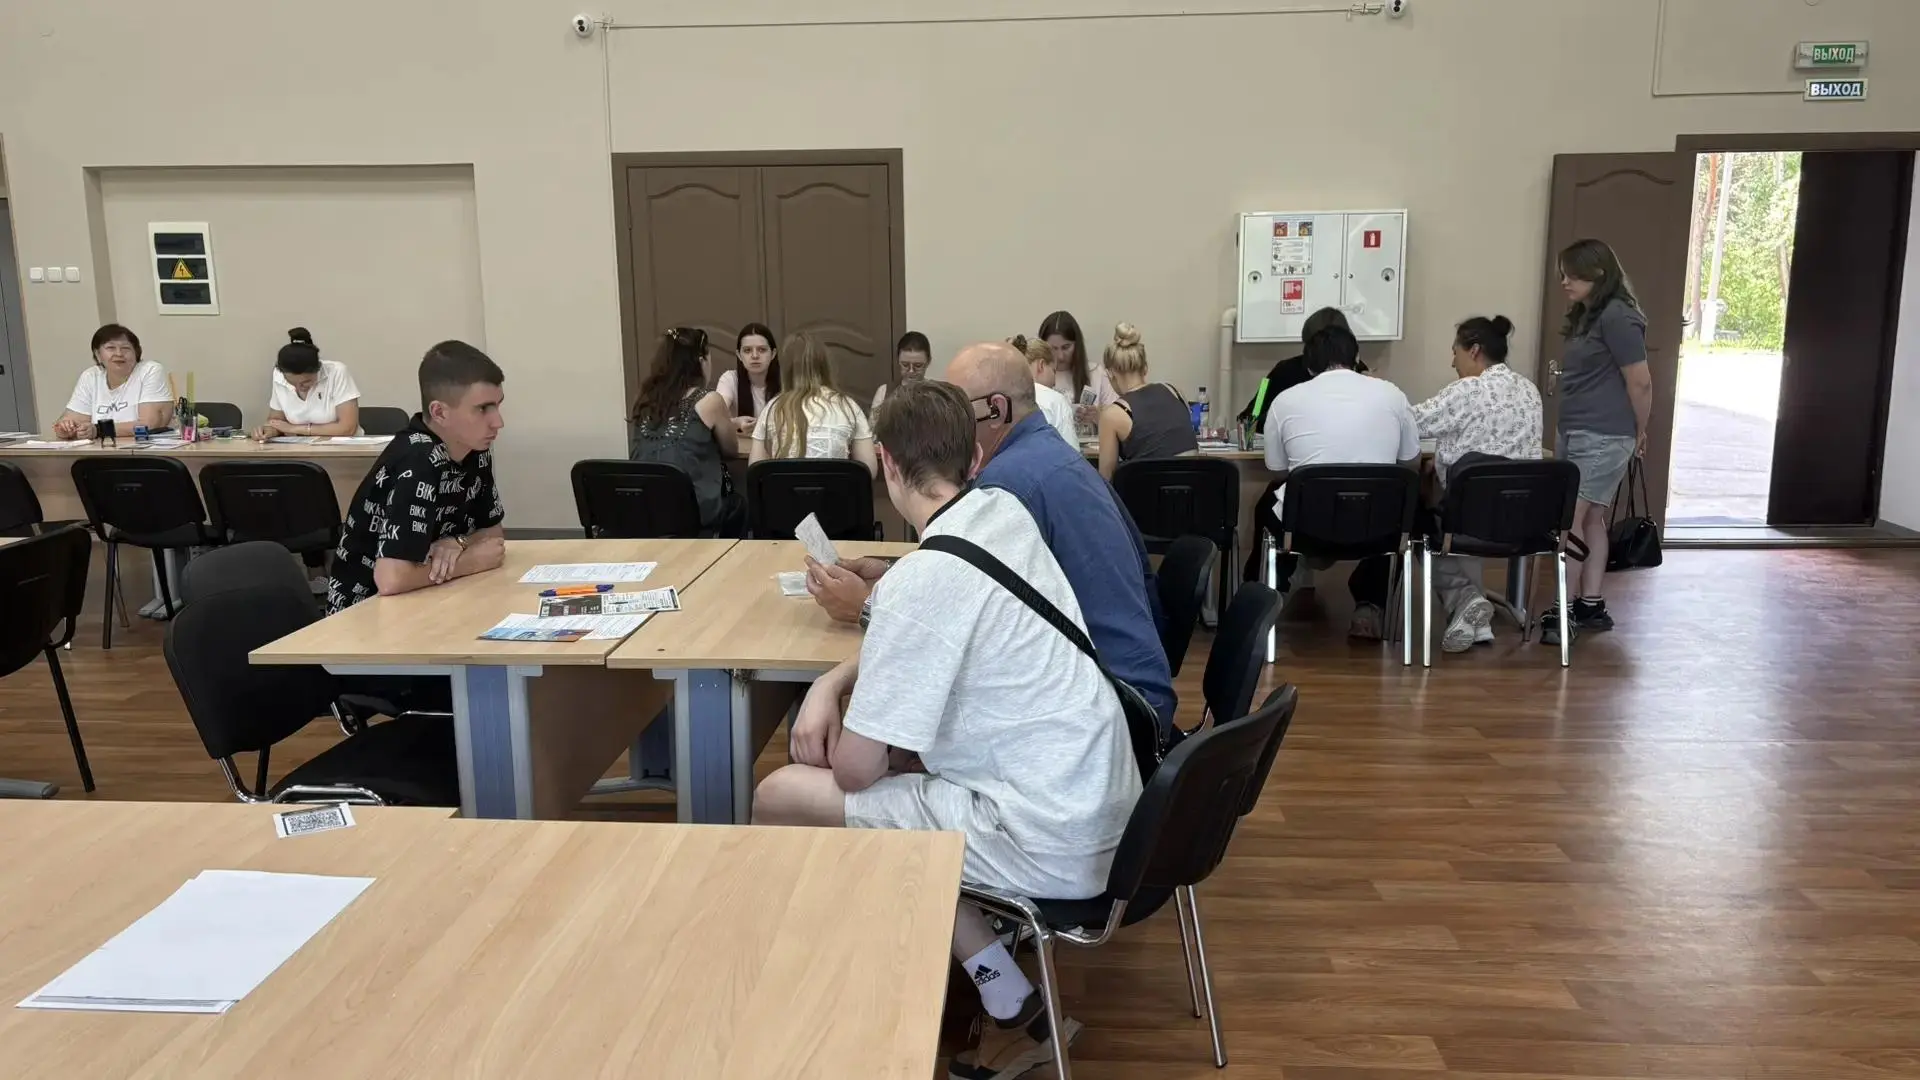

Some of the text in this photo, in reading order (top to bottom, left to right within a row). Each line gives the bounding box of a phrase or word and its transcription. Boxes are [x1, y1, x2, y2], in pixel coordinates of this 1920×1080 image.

[1814, 47, 1854, 62] ВЫХОД
[1810, 83, 1861, 96] ВЫХОД
[976, 970, 1000, 985] adidas
